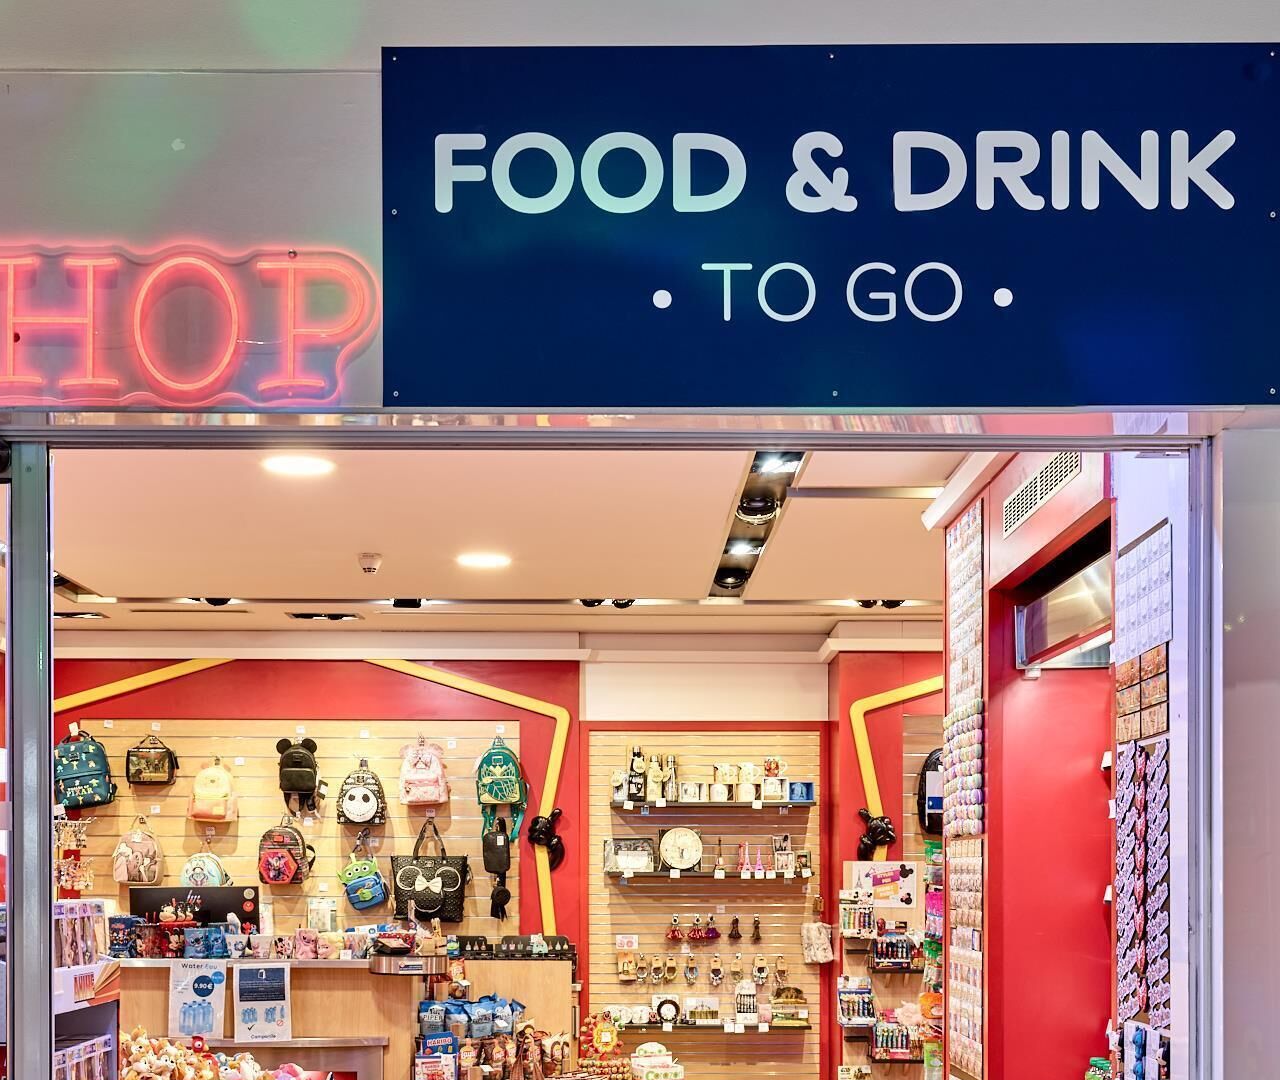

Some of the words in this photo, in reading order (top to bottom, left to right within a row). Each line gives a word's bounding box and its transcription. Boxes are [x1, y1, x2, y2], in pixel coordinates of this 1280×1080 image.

[433, 131, 748, 214] FOOD
[785, 130, 859, 214] &
[892, 129, 1237, 213] DRINK
[701, 261, 816, 323] TO
[846, 260, 964, 323] GO
[426, 1037, 453, 1047] HARIBO
